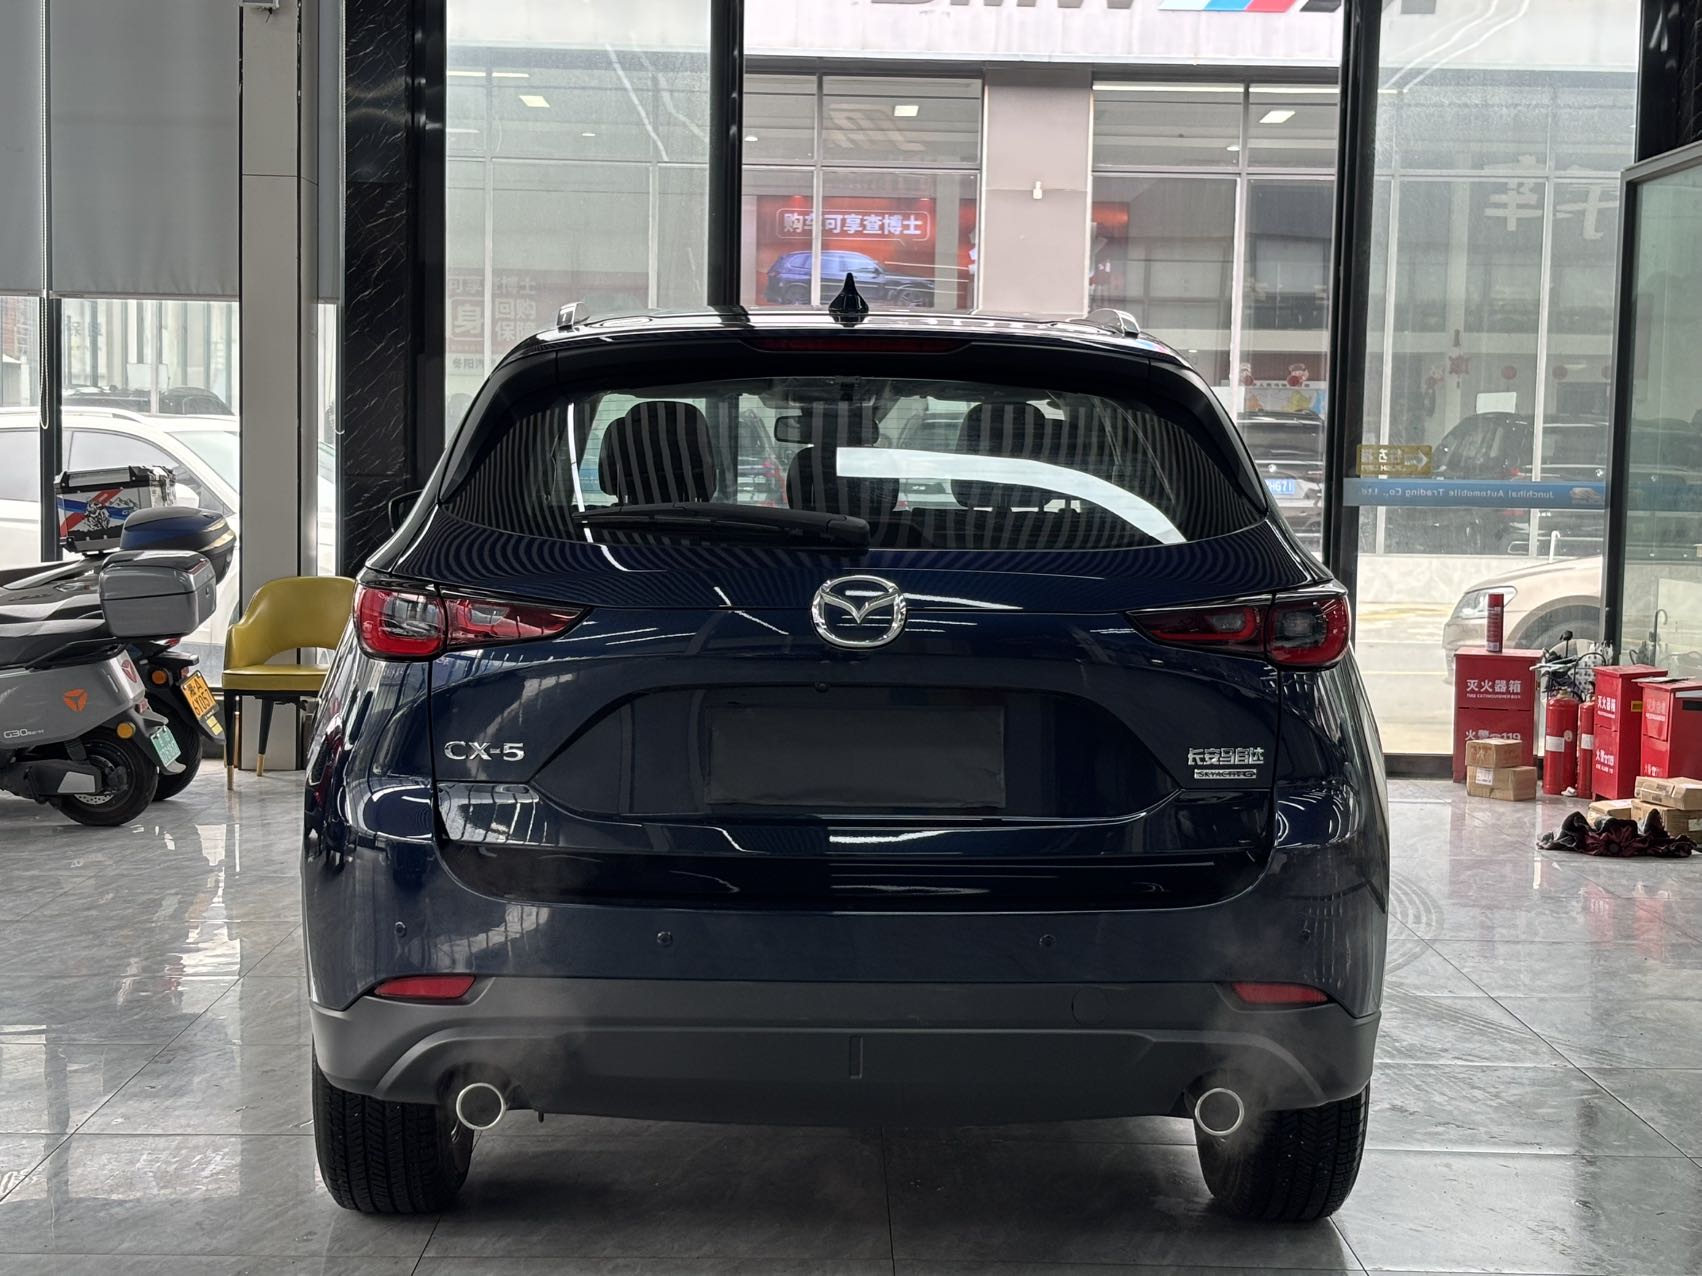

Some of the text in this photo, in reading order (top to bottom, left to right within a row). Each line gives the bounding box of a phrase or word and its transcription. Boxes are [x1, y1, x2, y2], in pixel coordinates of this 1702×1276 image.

[1466, 679, 1521, 693] 灭火器箱
[444, 741, 525, 761] CX-5
[1187, 747, 1264, 765] 长安马自达
